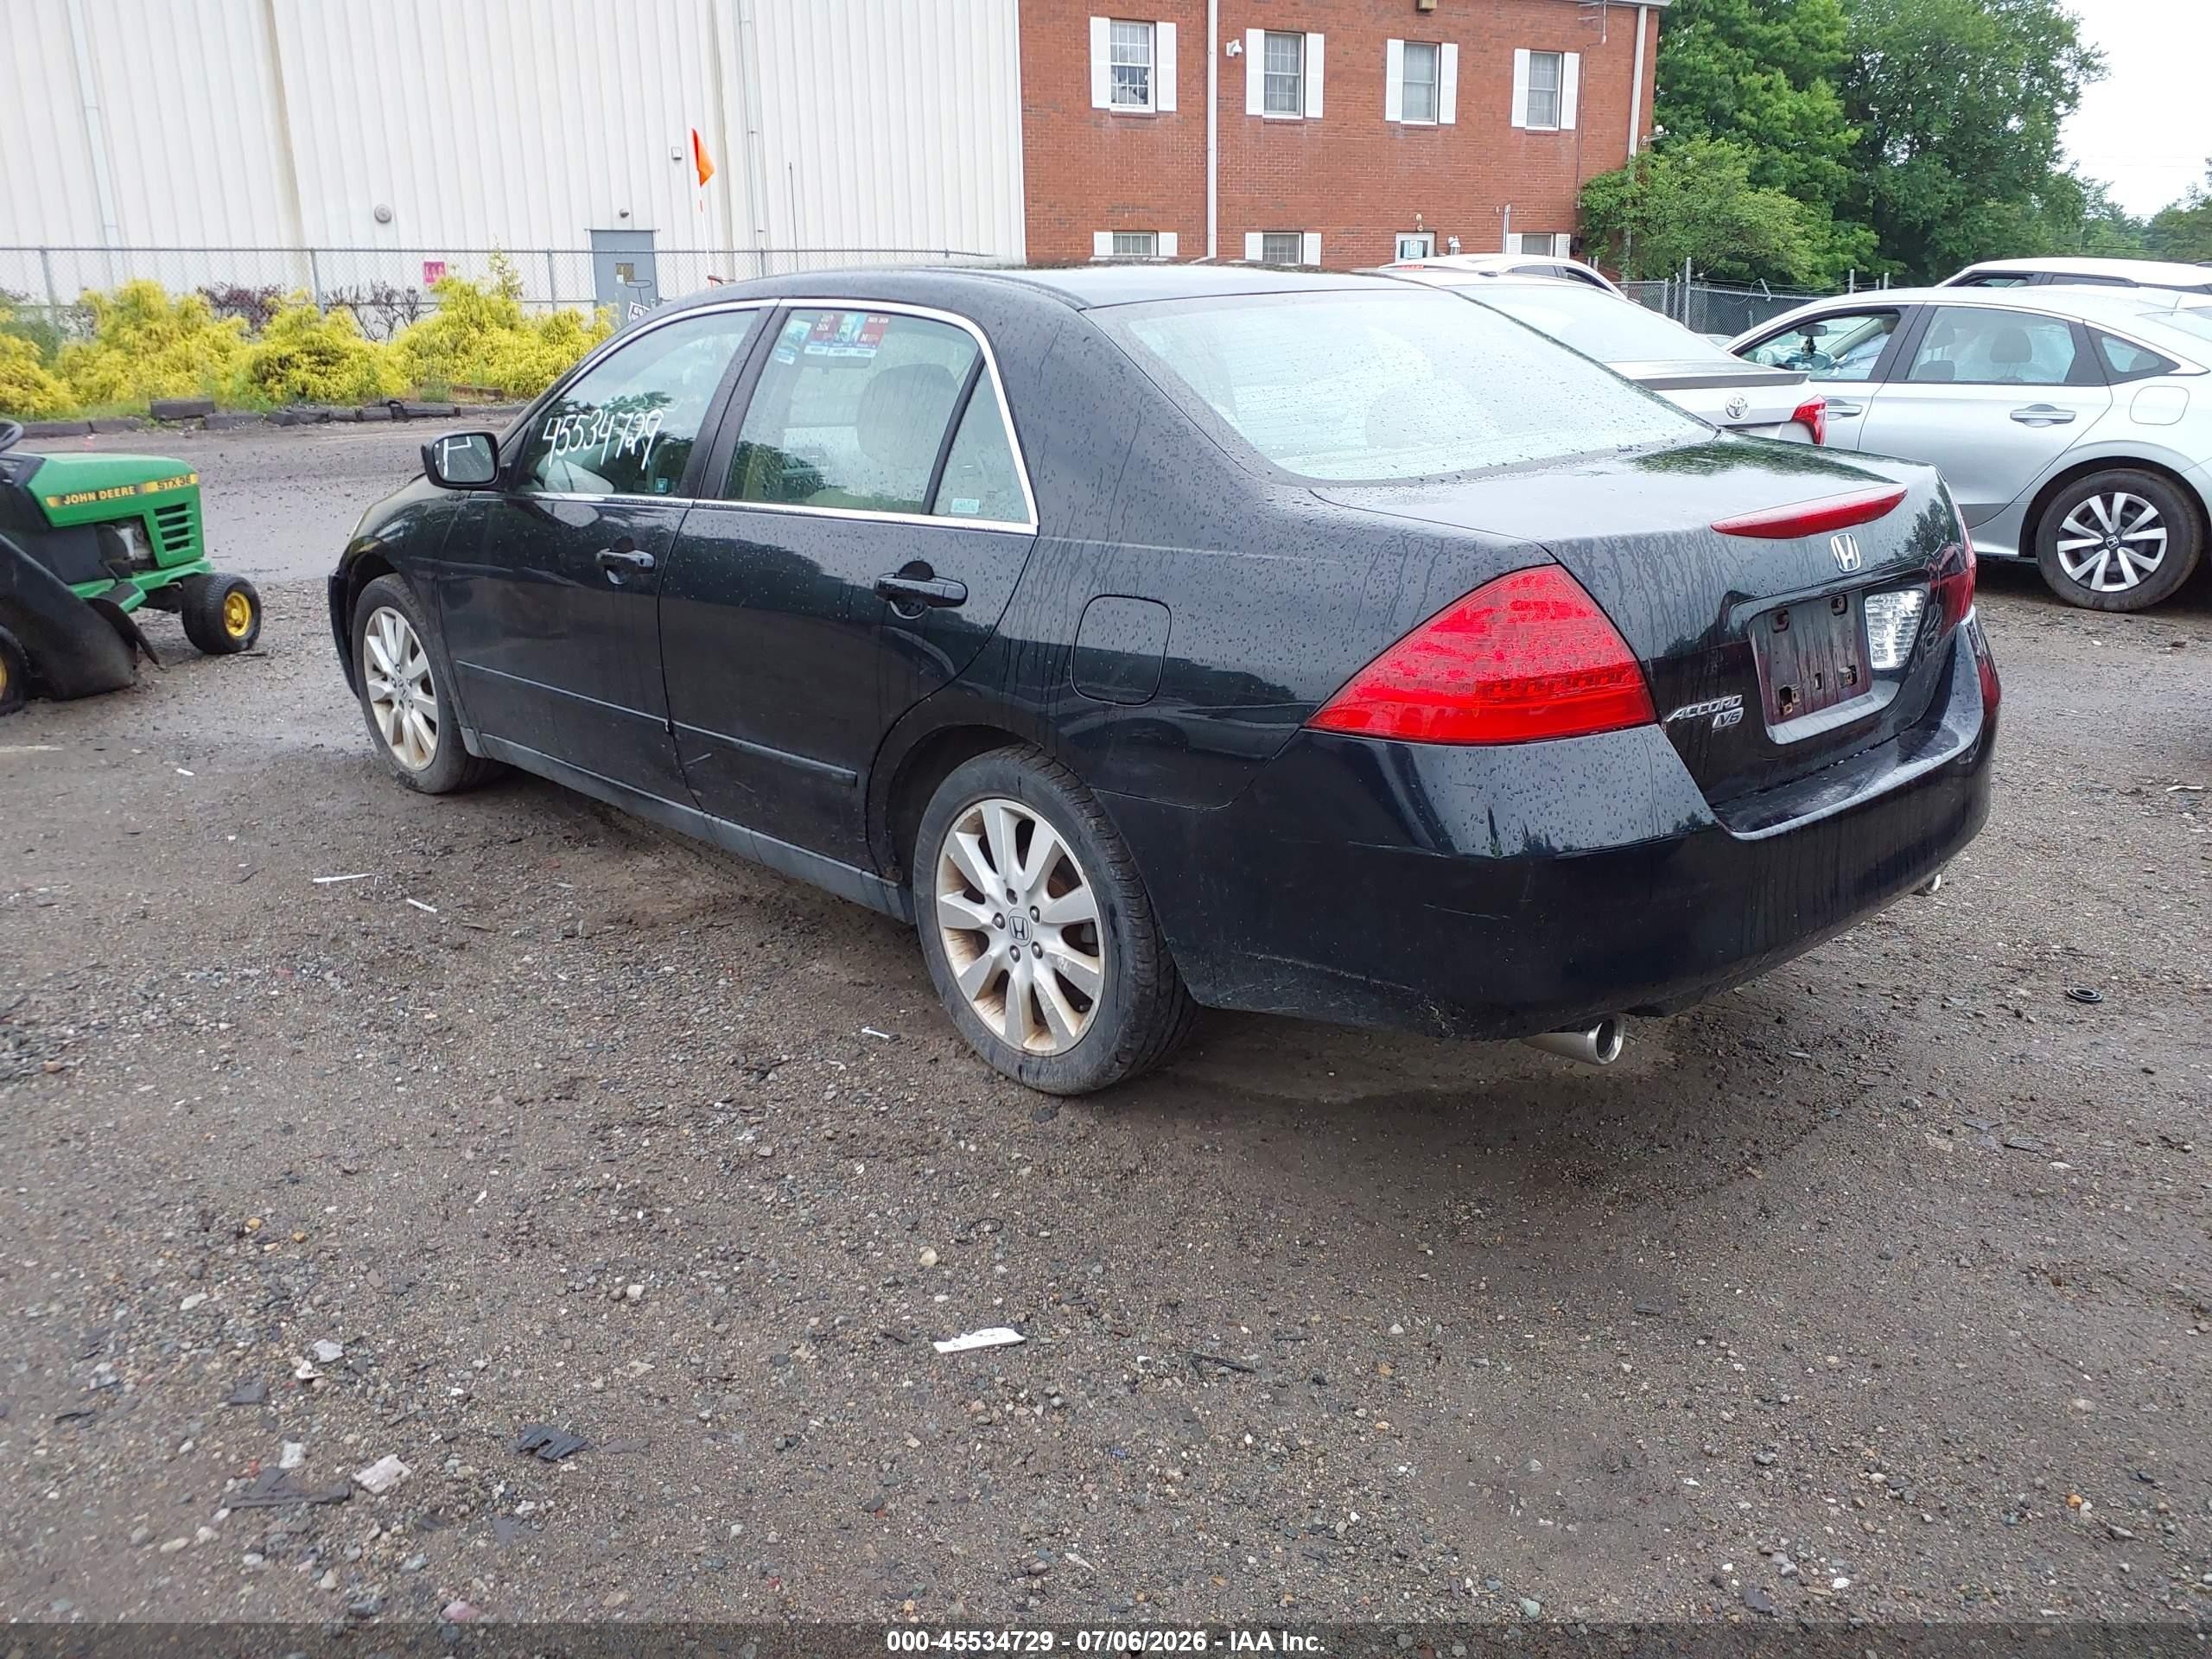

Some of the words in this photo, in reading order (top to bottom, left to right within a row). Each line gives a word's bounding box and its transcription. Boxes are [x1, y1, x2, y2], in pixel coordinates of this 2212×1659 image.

[542, 408, 664, 471] 45534729
[63, 492, 96, 505] JOHN
[99, 486, 136, 500] DEERE
[1664, 694, 1743, 722] ACCORD
[1715, 708, 1743, 727] V6
